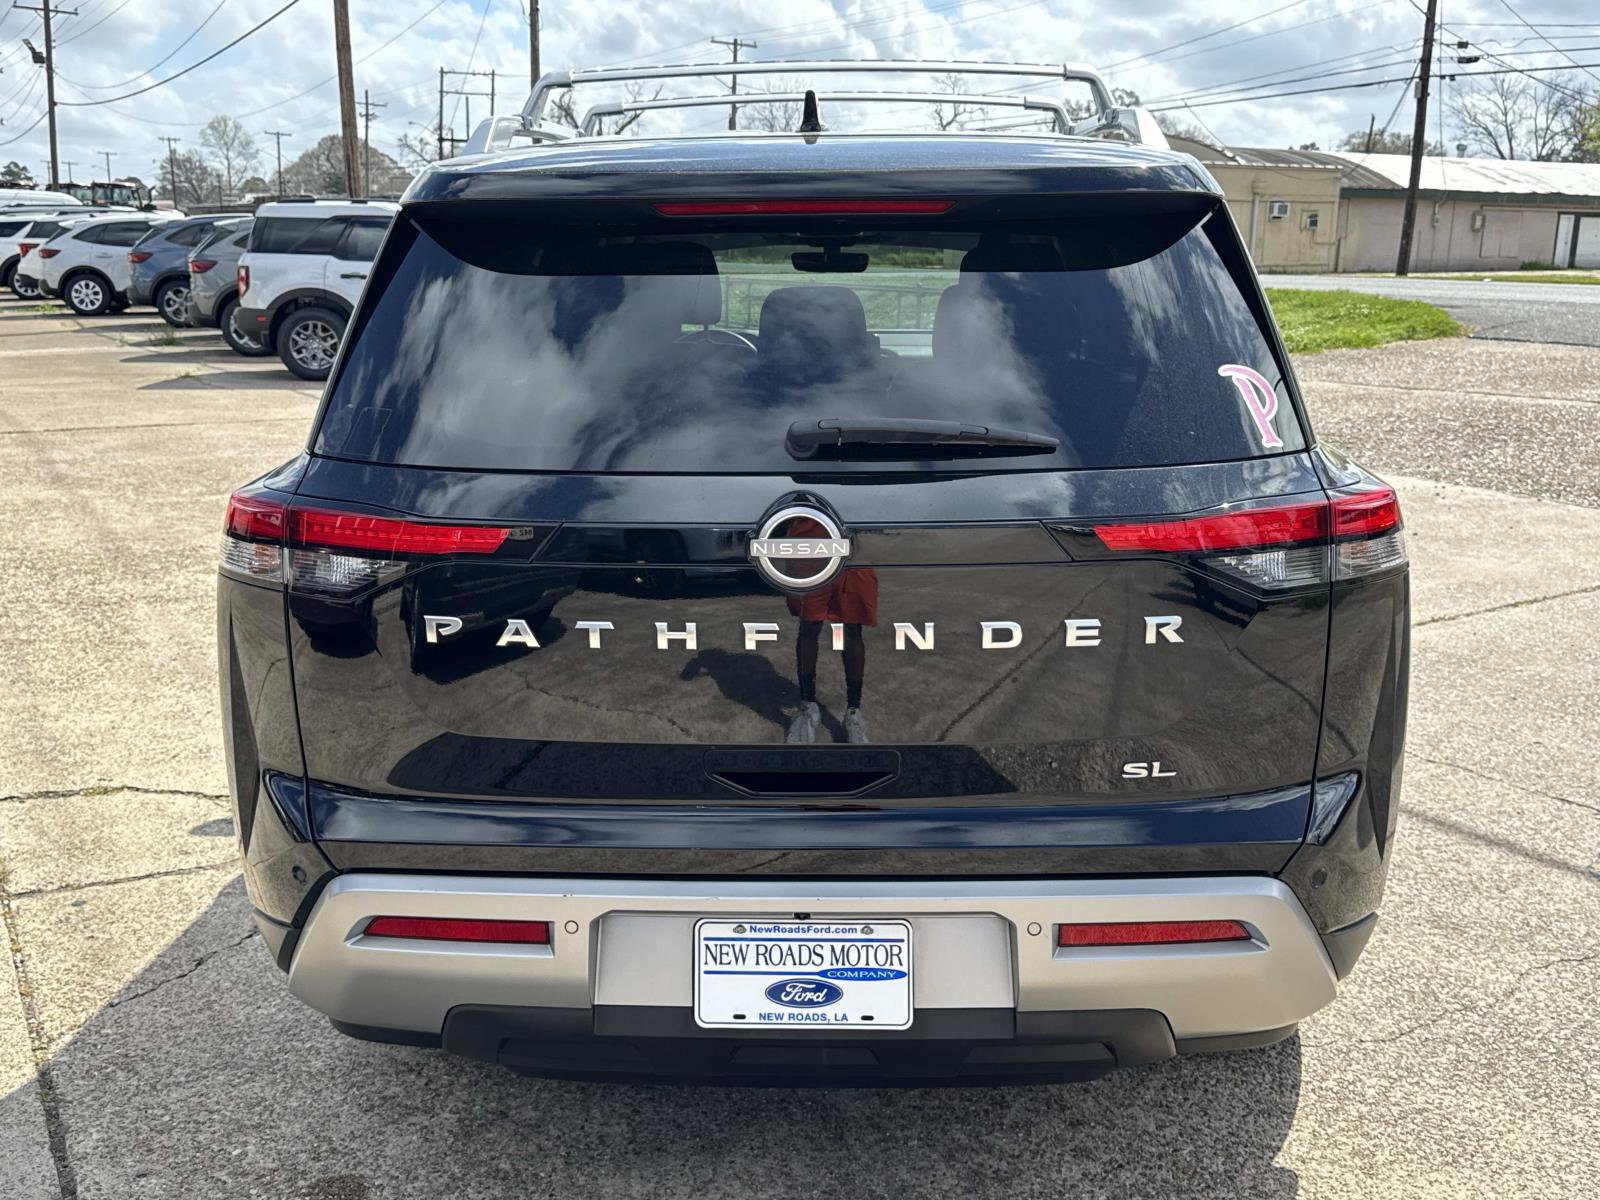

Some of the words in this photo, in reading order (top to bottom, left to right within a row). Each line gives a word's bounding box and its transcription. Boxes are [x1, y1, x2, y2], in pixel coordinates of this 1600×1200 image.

[1218, 364, 1283, 448] P
[753, 542, 847, 555] NISSAN
[424, 614, 1184, 651] PATHFINDER
[1121, 761, 1177, 779] SL
[749, 925, 858, 935] NewRoadsFord.com
[704, 943, 750, 966] NEW
[755, 943, 824, 967] ROADS
[830, 944, 904, 967] MOTOR
[827, 970, 897, 979] COMPANY
[780, 982, 827, 1003] Ford
[758, 1013, 785, 1022] NEW
[788, 1013, 830, 1024] ROADS,
[834, 1013, 849, 1023] LA
